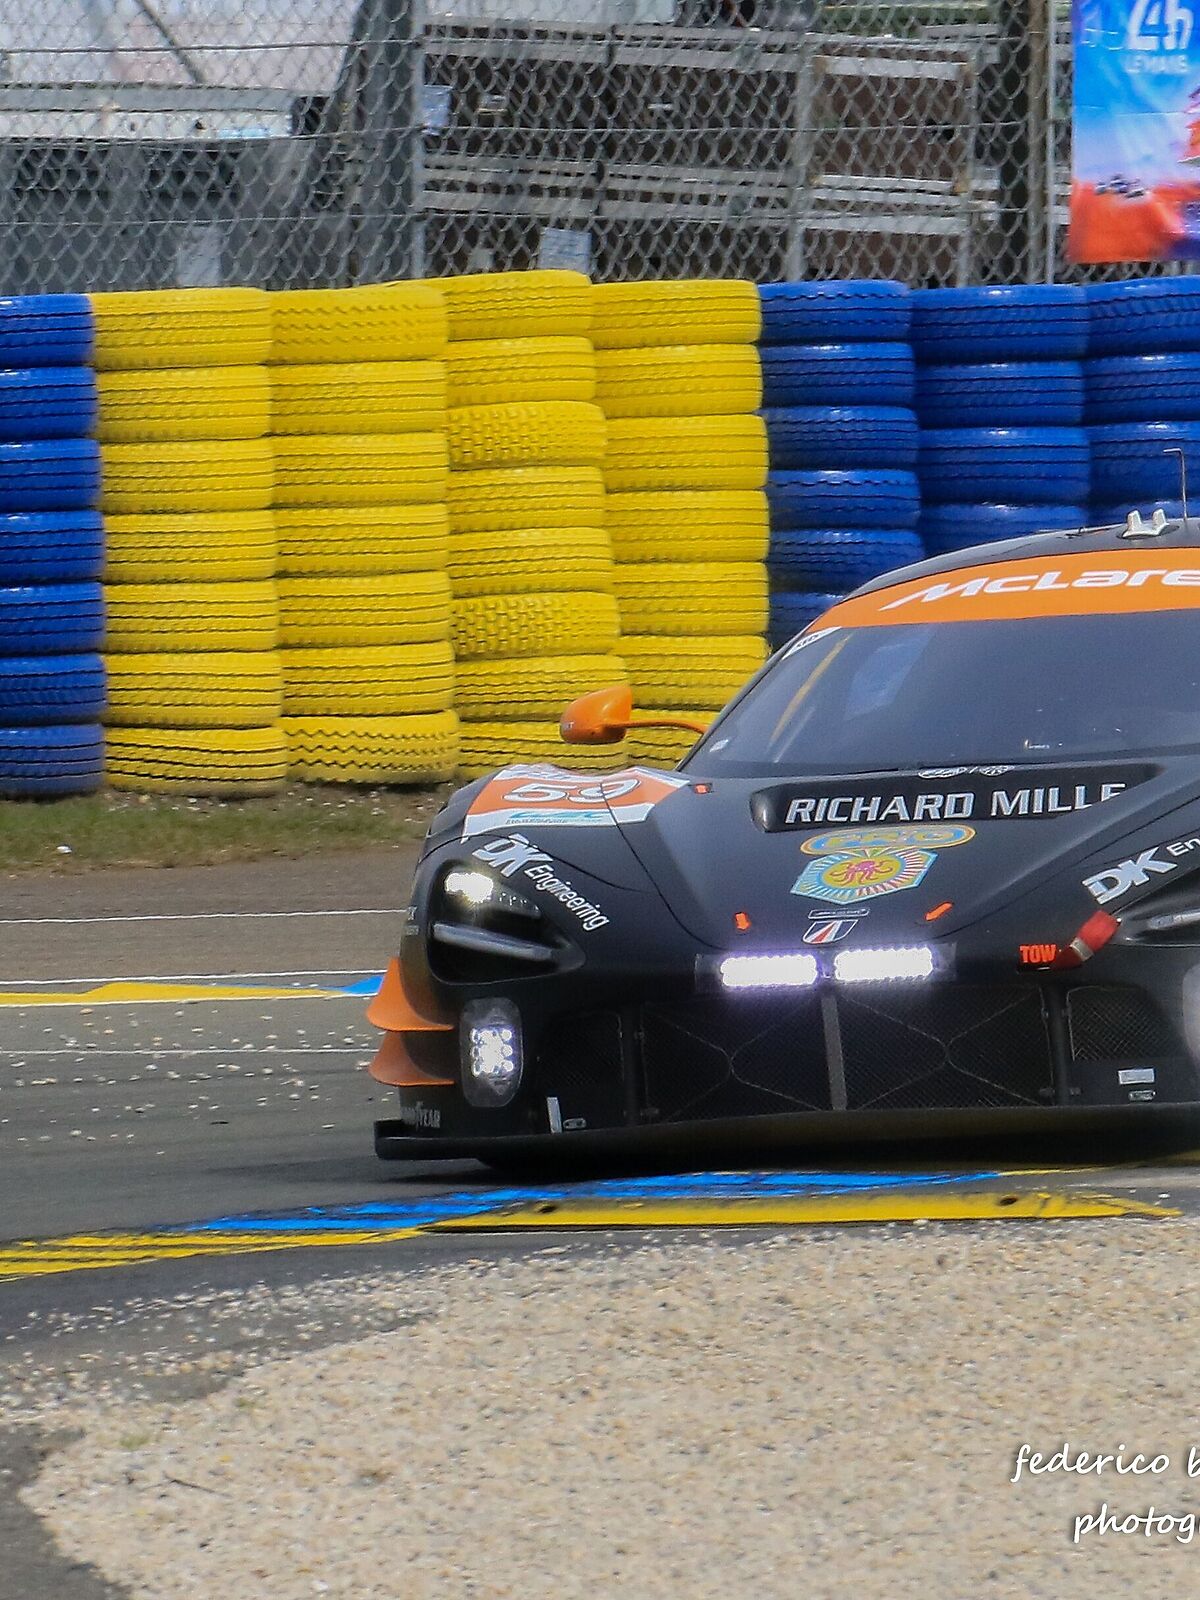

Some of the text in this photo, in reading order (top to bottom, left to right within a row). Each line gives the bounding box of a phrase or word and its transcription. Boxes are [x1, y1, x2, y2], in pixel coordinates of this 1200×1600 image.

[502, 779, 641, 803] 59
[785, 791, 976, 824] RICHARD
[471, 832, 610, 932] DK Engineering
[1081, 846, 1178, 905] DK
[1019, 943, 1057, 964] TOW
